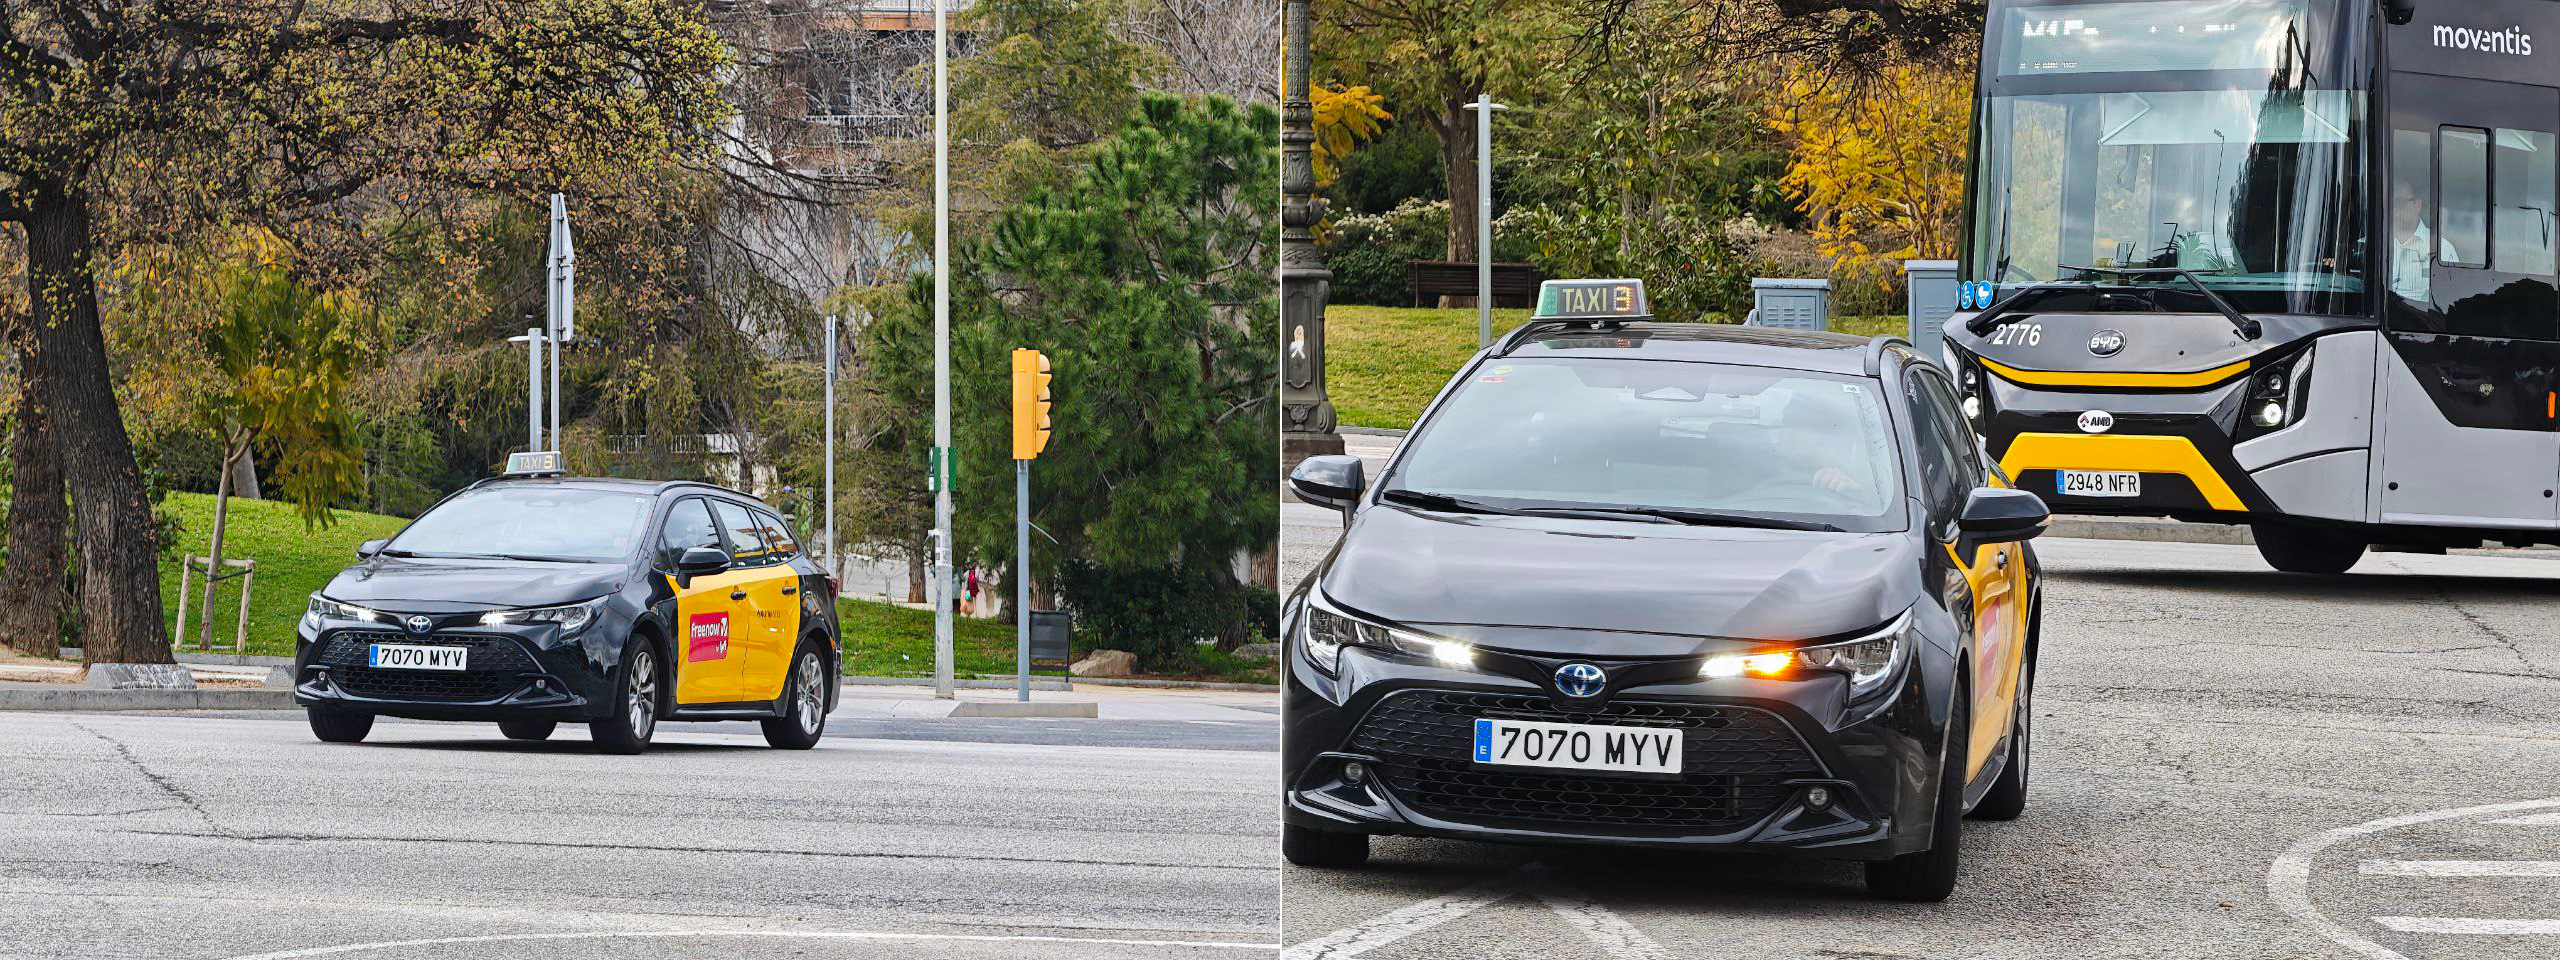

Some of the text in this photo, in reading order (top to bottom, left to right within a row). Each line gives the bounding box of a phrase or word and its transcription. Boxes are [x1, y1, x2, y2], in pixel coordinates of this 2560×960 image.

[2433, 25, 2532, 56] moventis
[1562, 287, 1607, 313] TAXI
[1993, 323, 2042, 347] 2776
[2090, 335, 2121, 349] BYD
[2090, 416, 2111, 427] AMB
[519, 456, 541, 470] TAXI
[2067, 473, 2103, 491] 2948
[2108, 475, 2137, 492] NFR
[691, 622, 720, 638] freenow
[381, 648, 462, 666] 7070 MYV
[1480, 727, 1673, 766] E 7070 MYV
